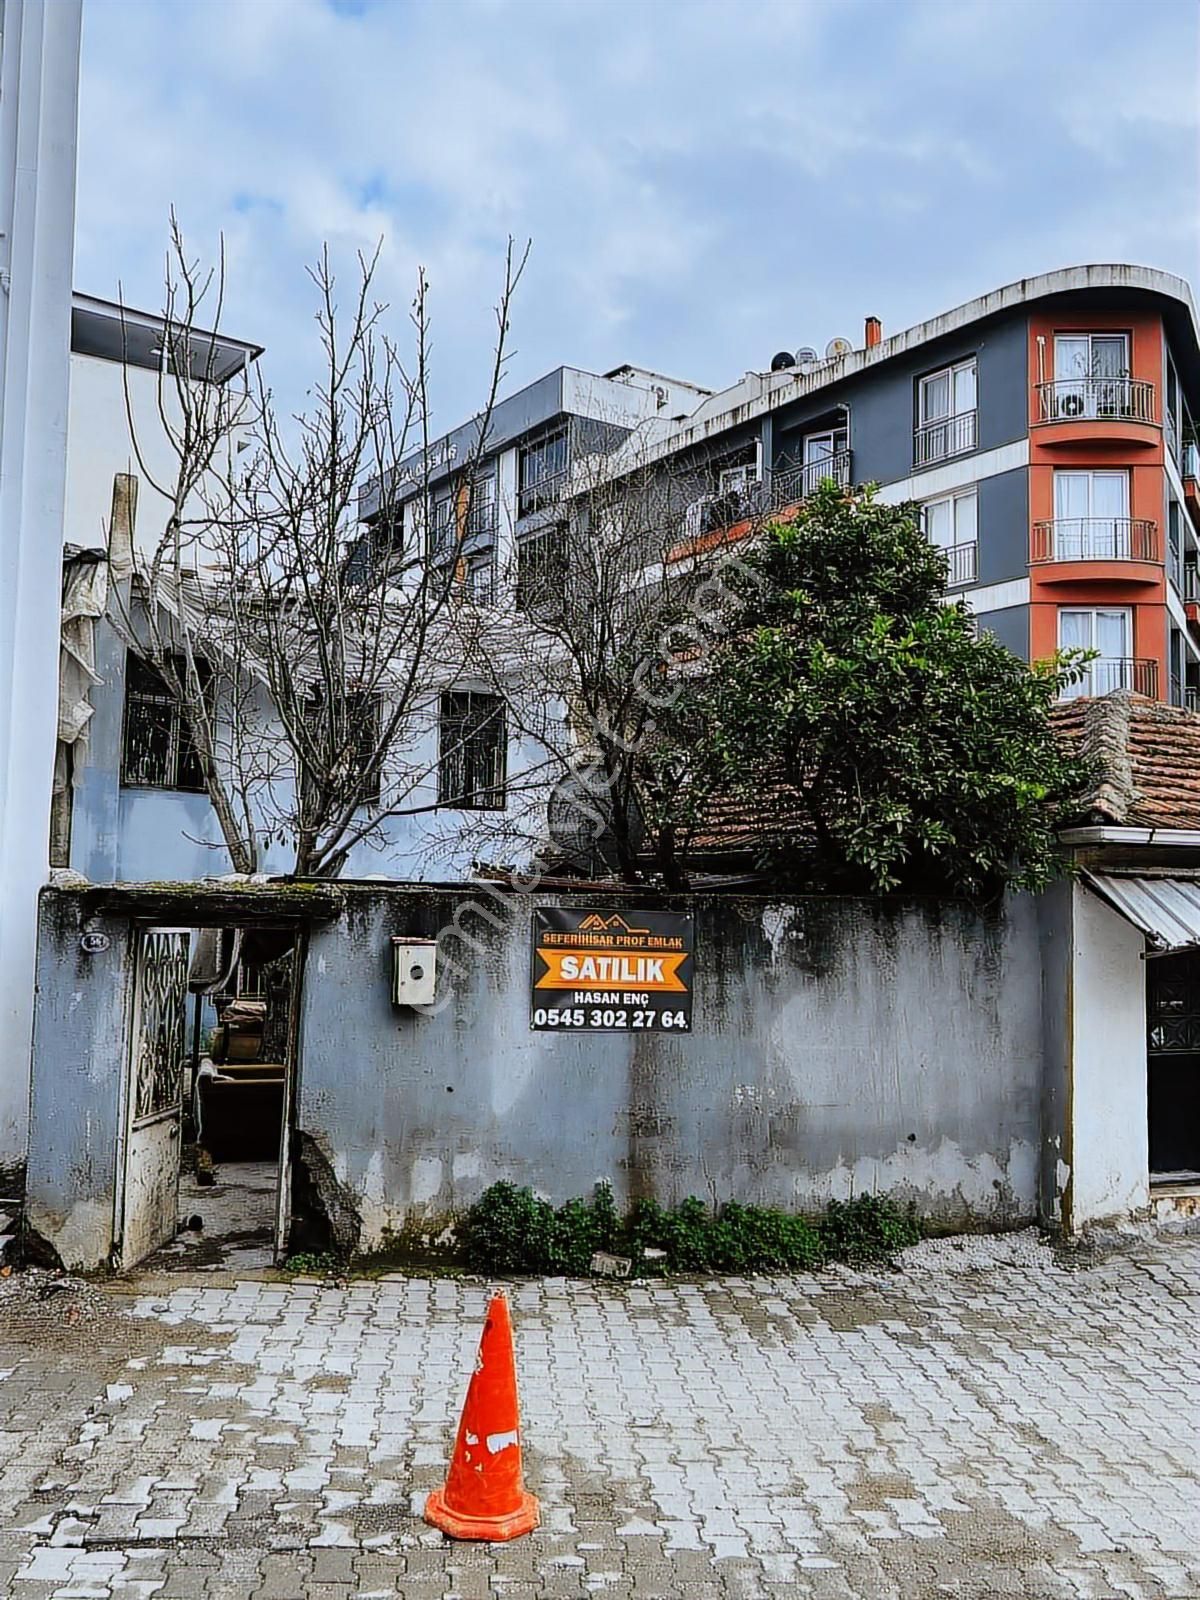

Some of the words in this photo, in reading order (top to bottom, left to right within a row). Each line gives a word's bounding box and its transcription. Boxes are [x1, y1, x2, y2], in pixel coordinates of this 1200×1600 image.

[616, 935, 647, 946] PROF
[647, 936, 683, 948] EMLAK
[560, 956, 665, 982] SATILIK
[574, 992, 620, 1005] HASAN
[623, 993, 649, 1008] ENÇ
[534, 1009, 585, 1027] 0545
[590, 1009, 627, 1027] 302
[632, 1011, 656, 1028] 27
[661, 1011, 686, 1028] 64
